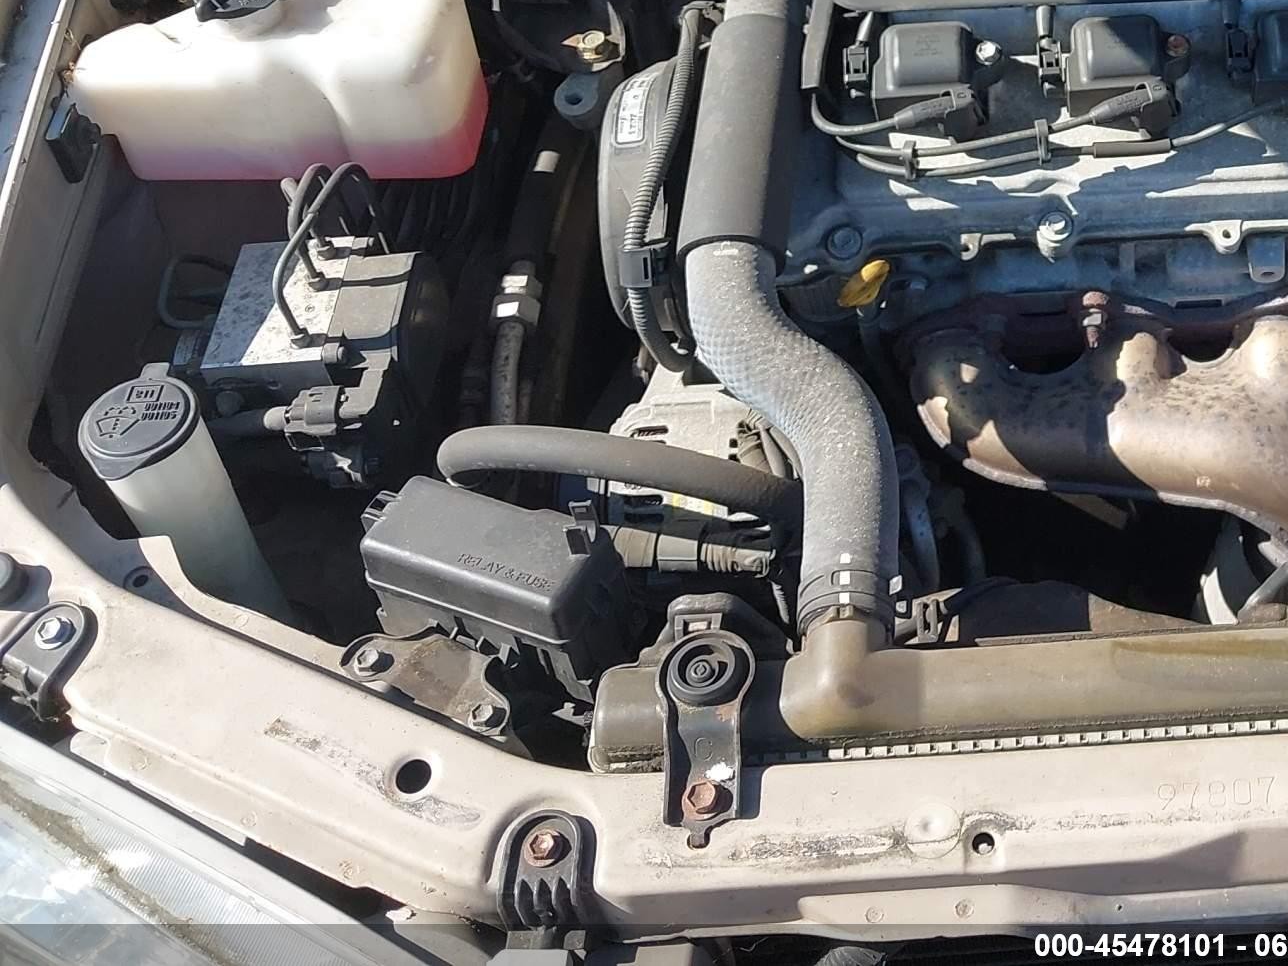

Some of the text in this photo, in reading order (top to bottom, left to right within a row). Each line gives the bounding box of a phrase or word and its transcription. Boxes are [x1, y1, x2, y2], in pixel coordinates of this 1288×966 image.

[457, 553, 556, 592] RELAY & FUSE
[1156, 775, 1276, 811] 97807
